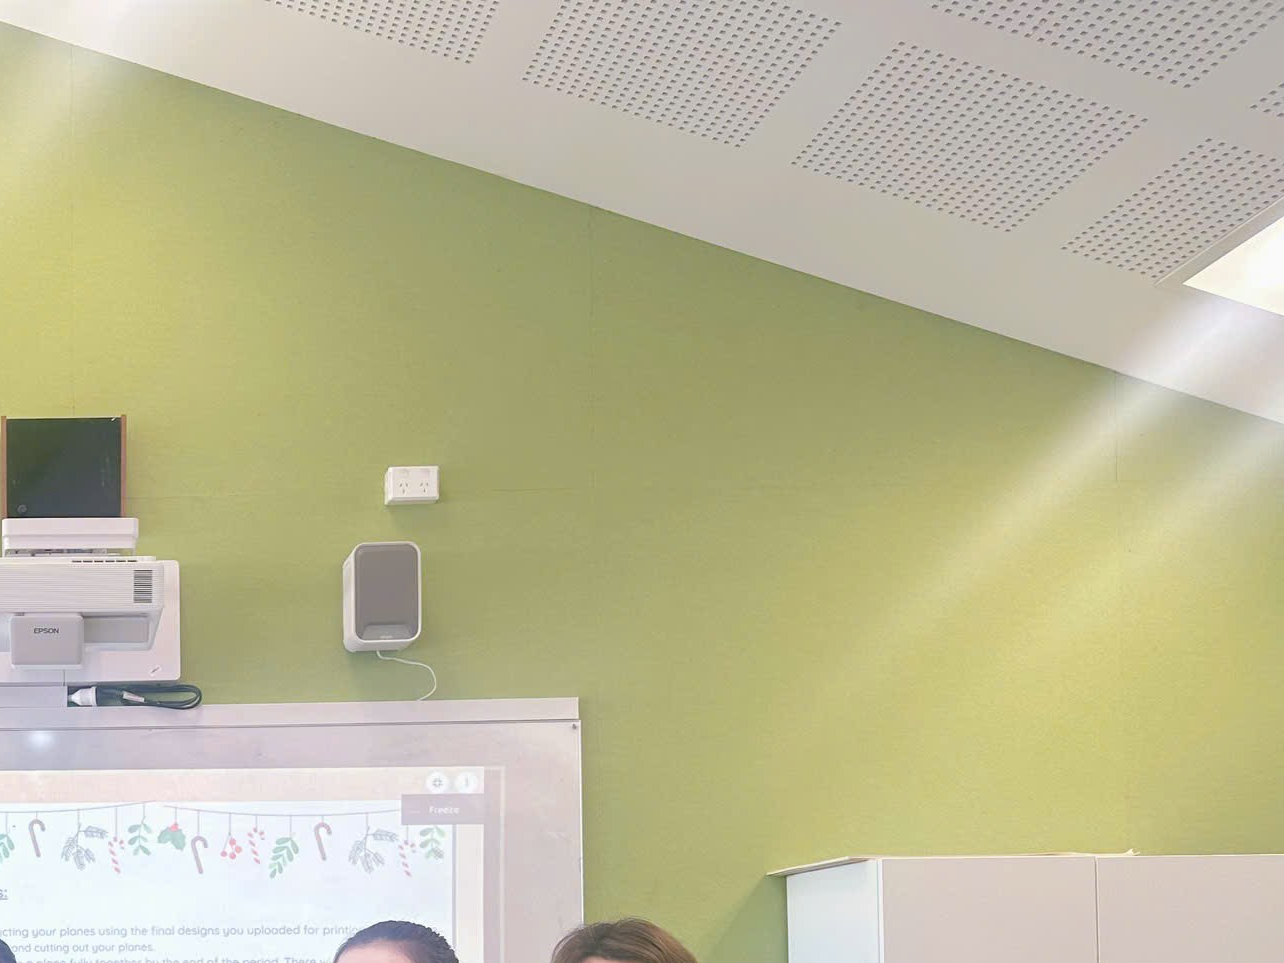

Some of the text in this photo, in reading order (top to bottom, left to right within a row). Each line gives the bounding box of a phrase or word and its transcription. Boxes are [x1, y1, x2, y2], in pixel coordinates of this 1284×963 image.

[32, 928, 56, 938] your
[60, 926, 96, 937] planes
[99, 926, 128, 938] using
[131, 926, 149, 936] the
[151, 925, 175, 936] final
[178, 925, 220, 937] designs
[223, 927, 245, 937] you
[247, 925, 301, 937] uploaded
[304, 924, 320, 935] for
[34, 943, 69, 954] cutting
[72, 944, 89, 952] out
[92, 944, 115, 954] your
[118, 943, 154, 953] planes.
